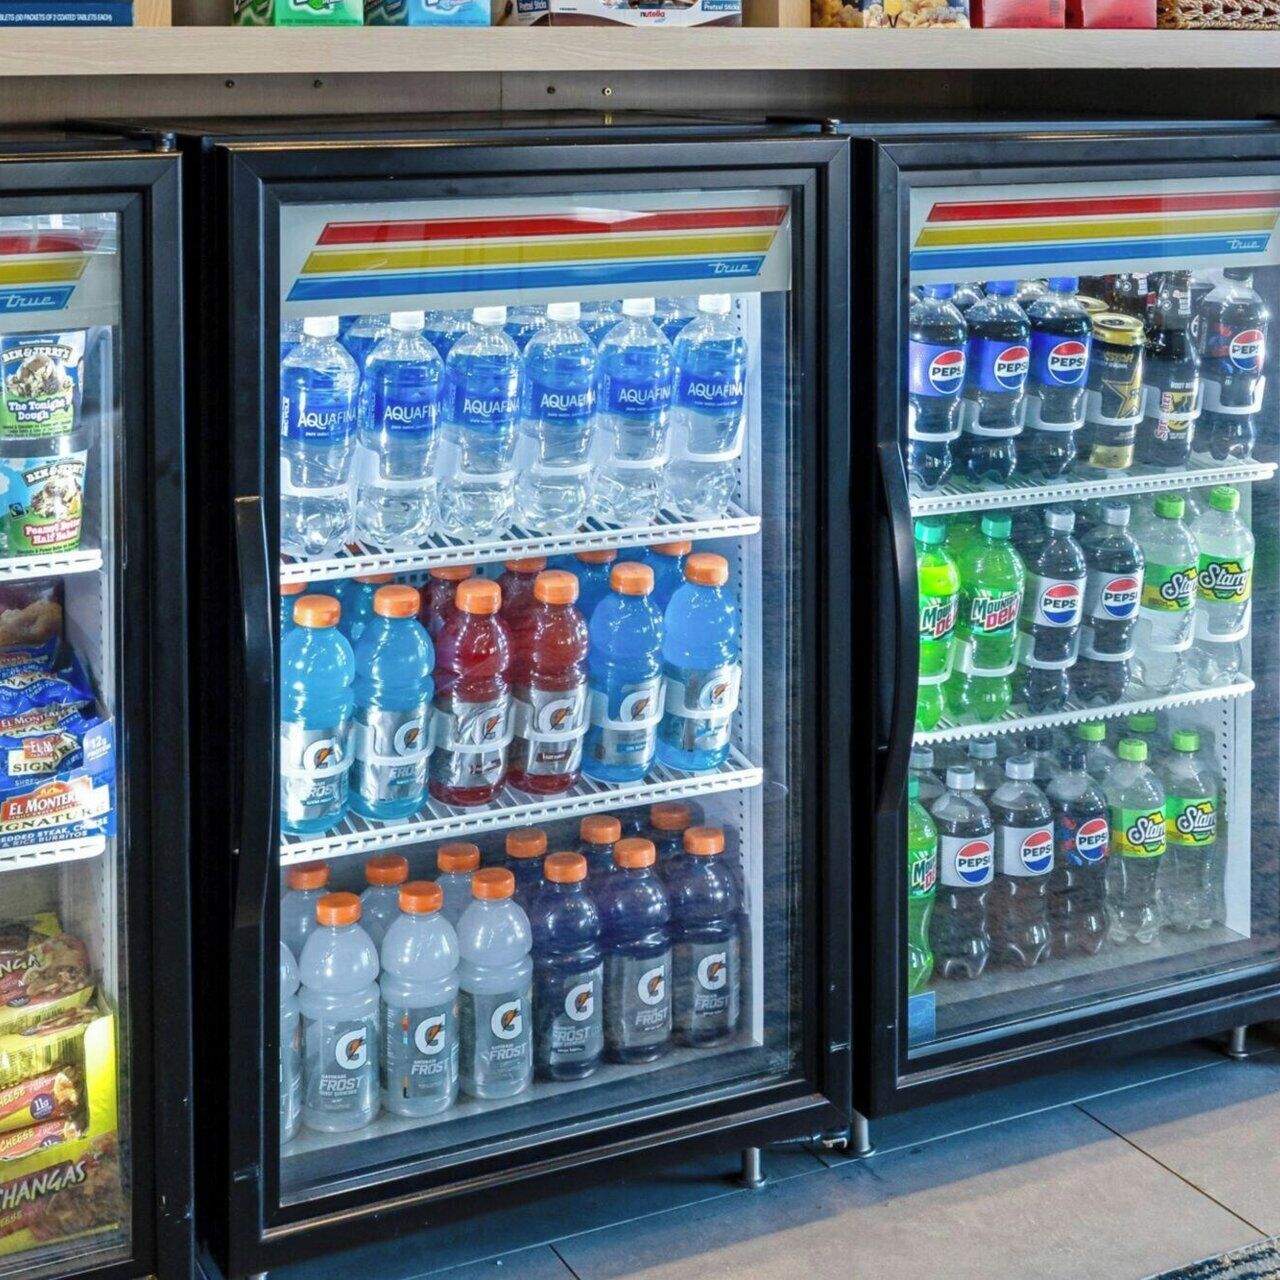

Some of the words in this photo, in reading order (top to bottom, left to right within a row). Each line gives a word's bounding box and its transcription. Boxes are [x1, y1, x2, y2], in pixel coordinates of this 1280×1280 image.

[518, 0, 533, 11] Pretzel
[533, 0, 548, 11] Sticks
[639, 10, 666, 19] nutella
[703, 3, 723, 11] Pretzel
[724, 3, 741, 11] Sticks
[2, 349, 23, 362] BEN
[32, 346, 70, 360] JERRY'S
[687, 381, 744, 400] AQUAFINA
[17, 410, 50, 421] Dough
[463, 397, 519, 418] AQUAFINA
[12, 838, 37, 848] RICE
[38, 830, 88, 844] BURRITOS
[1022, 844, 1053, 859] PEPSI
[957, 856, 992, 869] PEPSI
[697, 951, 727, 991] G
[637, 964, 666, 1006] G
[564, 980, 594, 1022] G
[694, 995, 731, 1010] FROST
[490, 998, 522, 1041] G
[635, 1006, 669, 1027] FROST
[414, 1013, 446, 1056] G
[552, 1025, 592, 1043] FROST
[335, 1027, 368, 1070] G
[488, 1042, 528, 1061] FROST
[411, 1058, 450, 1076] FROST
[319, 1076, 363, 1091] FROST
